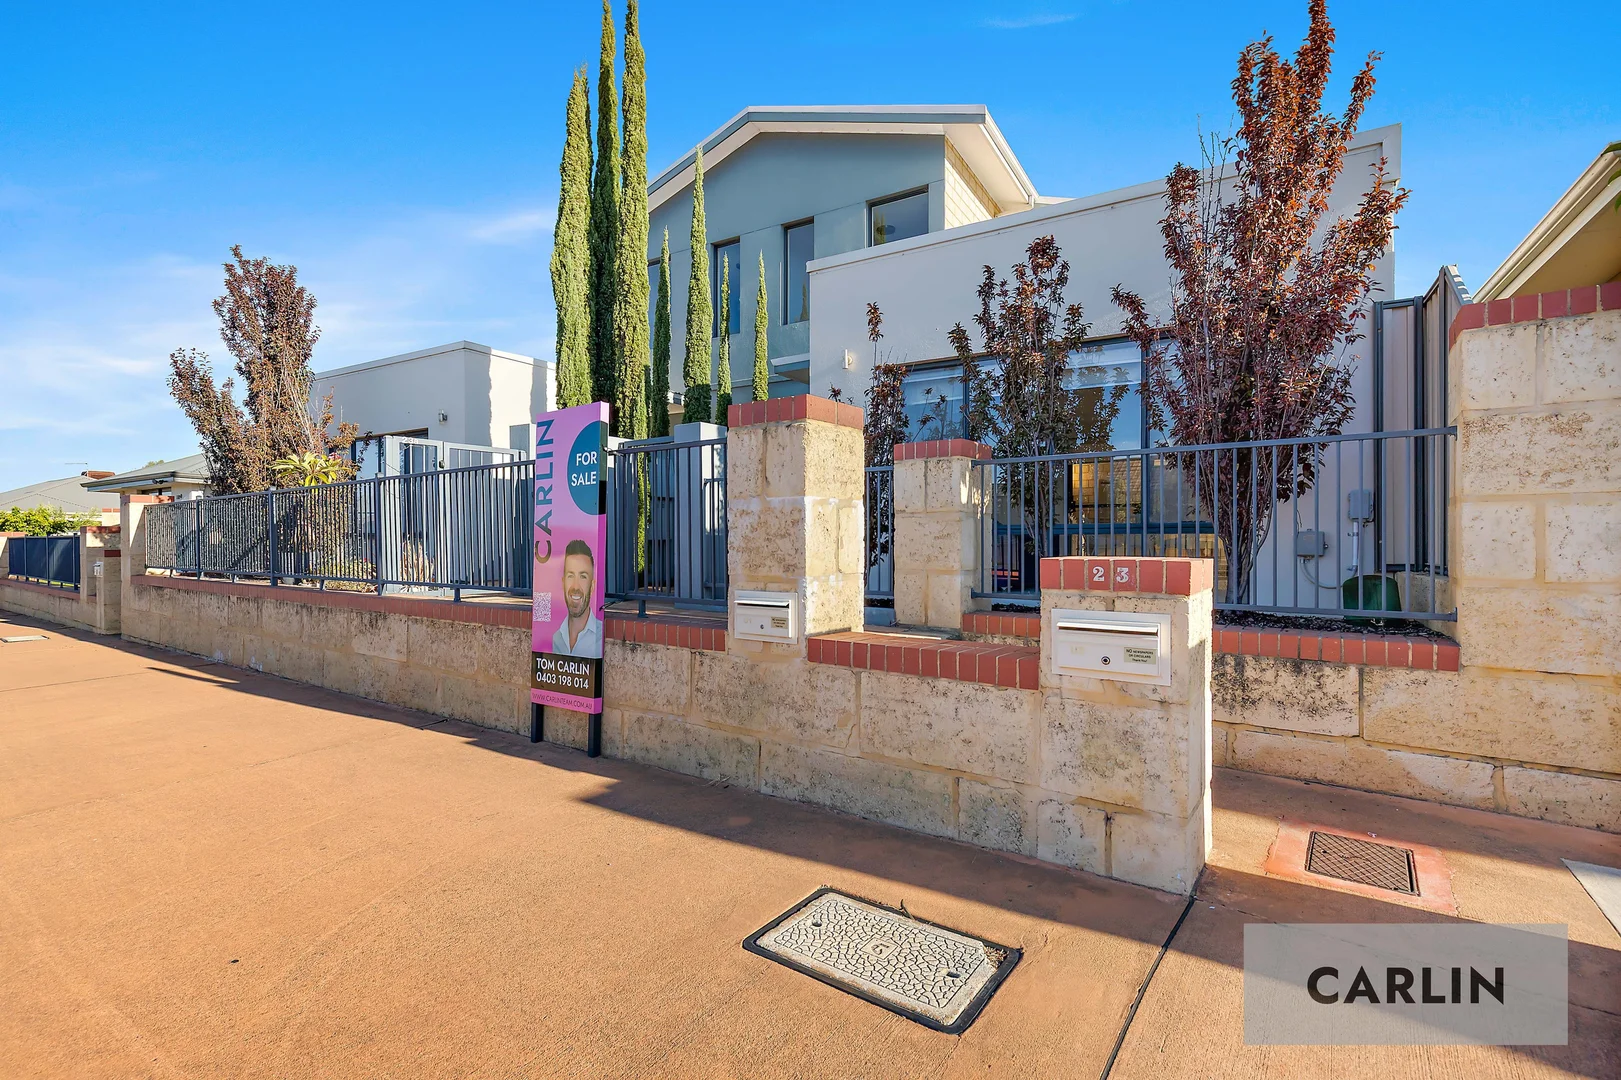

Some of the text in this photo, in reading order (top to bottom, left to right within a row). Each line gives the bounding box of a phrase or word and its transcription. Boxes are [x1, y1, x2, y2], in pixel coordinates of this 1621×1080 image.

[576, 451, 597, 466] FOR
[571, 472, 596, 486] SALE
[535, 419, 555, 563] CARLIN
[536, 658, 590, 675] TOM CARLIN
[536, 672, 589, 689] 0403 198 014
[532, 692, 593, 710] WWW.CARLINTEAM.COM.AU
